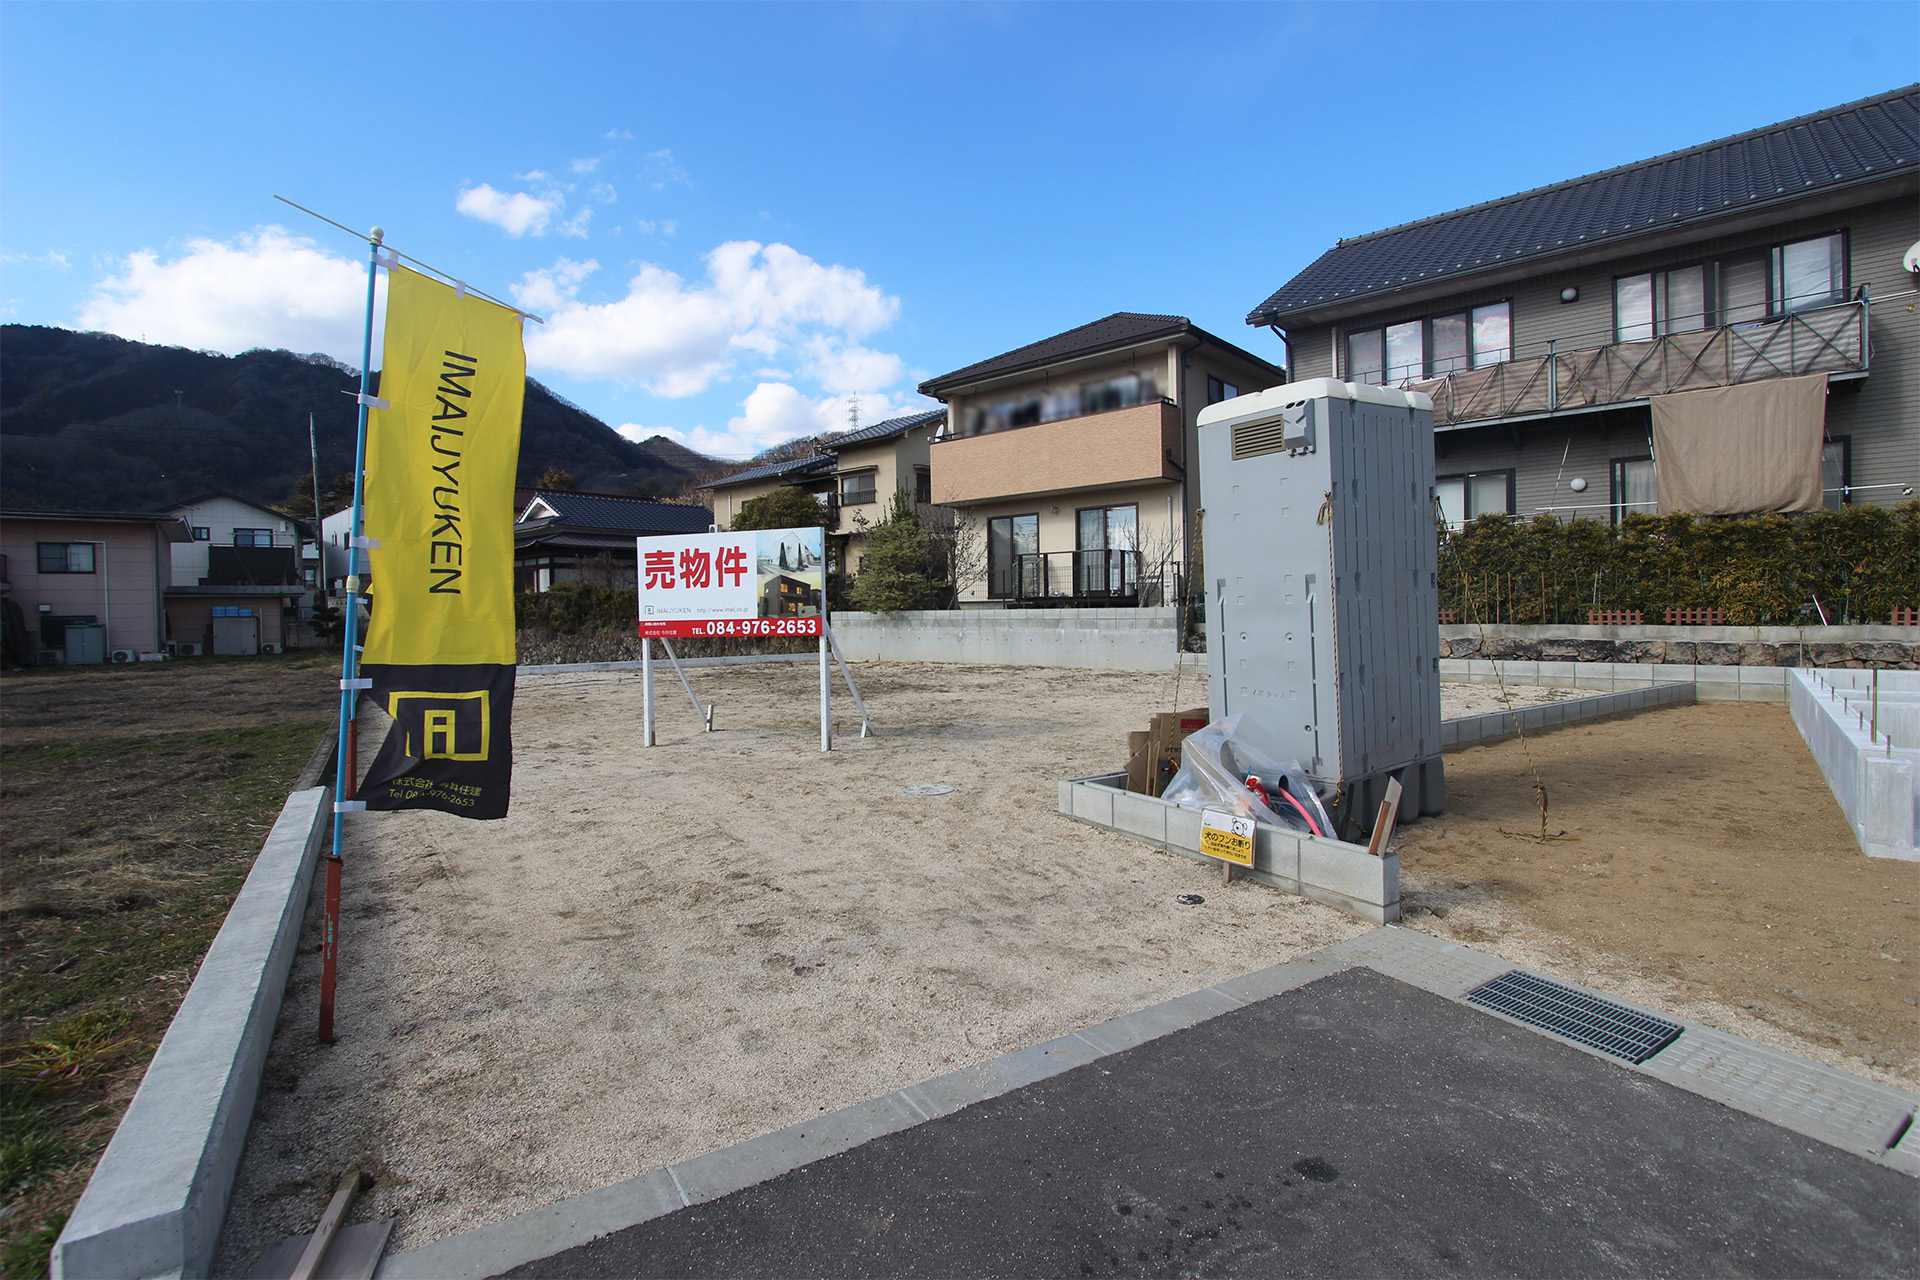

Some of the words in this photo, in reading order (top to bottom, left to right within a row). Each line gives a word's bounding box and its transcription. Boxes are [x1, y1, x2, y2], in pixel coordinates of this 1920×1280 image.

[429, 349, 478, 595] IMAIJYUKEN
[644, 545, 748, 590] 売物件
[691, 627, 706, 635] TEL.
[706, 619, 816, 636] 084-976-2653
[389, 789, 404, 798] Tel
[1204, 831, 1251, 850] 犬のフンお断り
